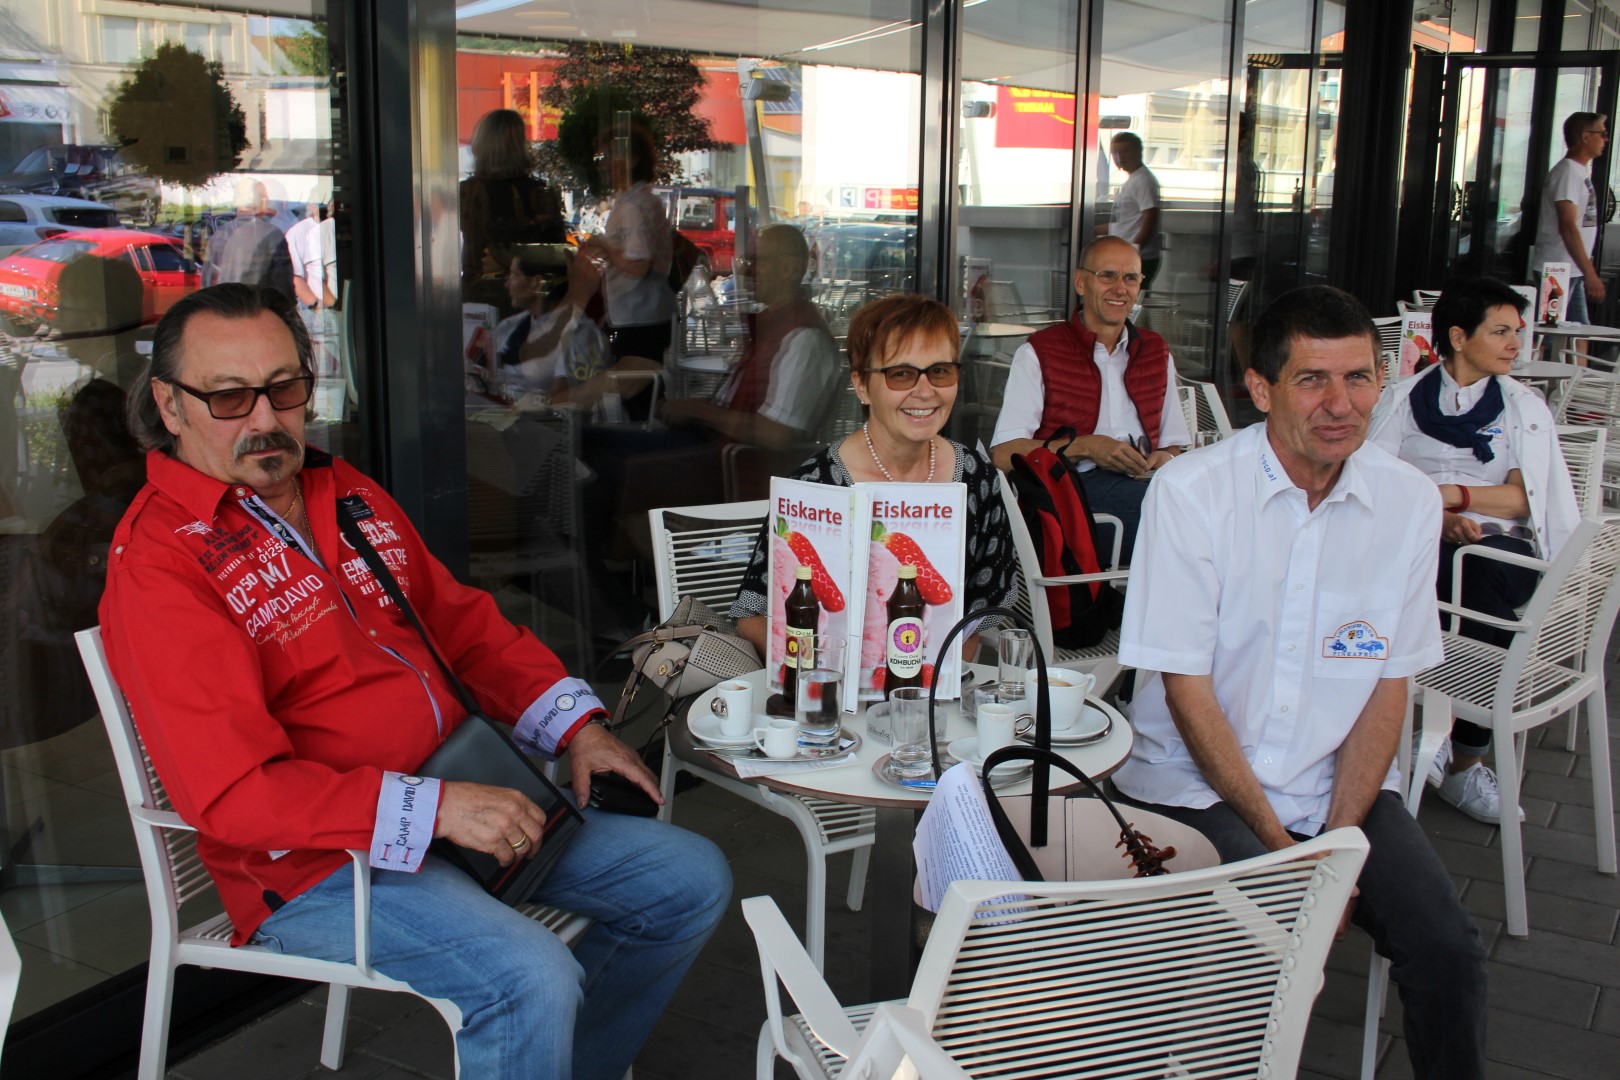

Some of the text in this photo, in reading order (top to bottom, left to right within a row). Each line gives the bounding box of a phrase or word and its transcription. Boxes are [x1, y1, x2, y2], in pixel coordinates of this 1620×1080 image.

[1408, 320, 1432, 330] Eiska
[777, 496, 842, 526] Eiskarte
[872, 501, 953, 519] Eiskarte
[890, 657, 921, 666] KOMBUCHA
[402, 786, 416, 812] DAVID
